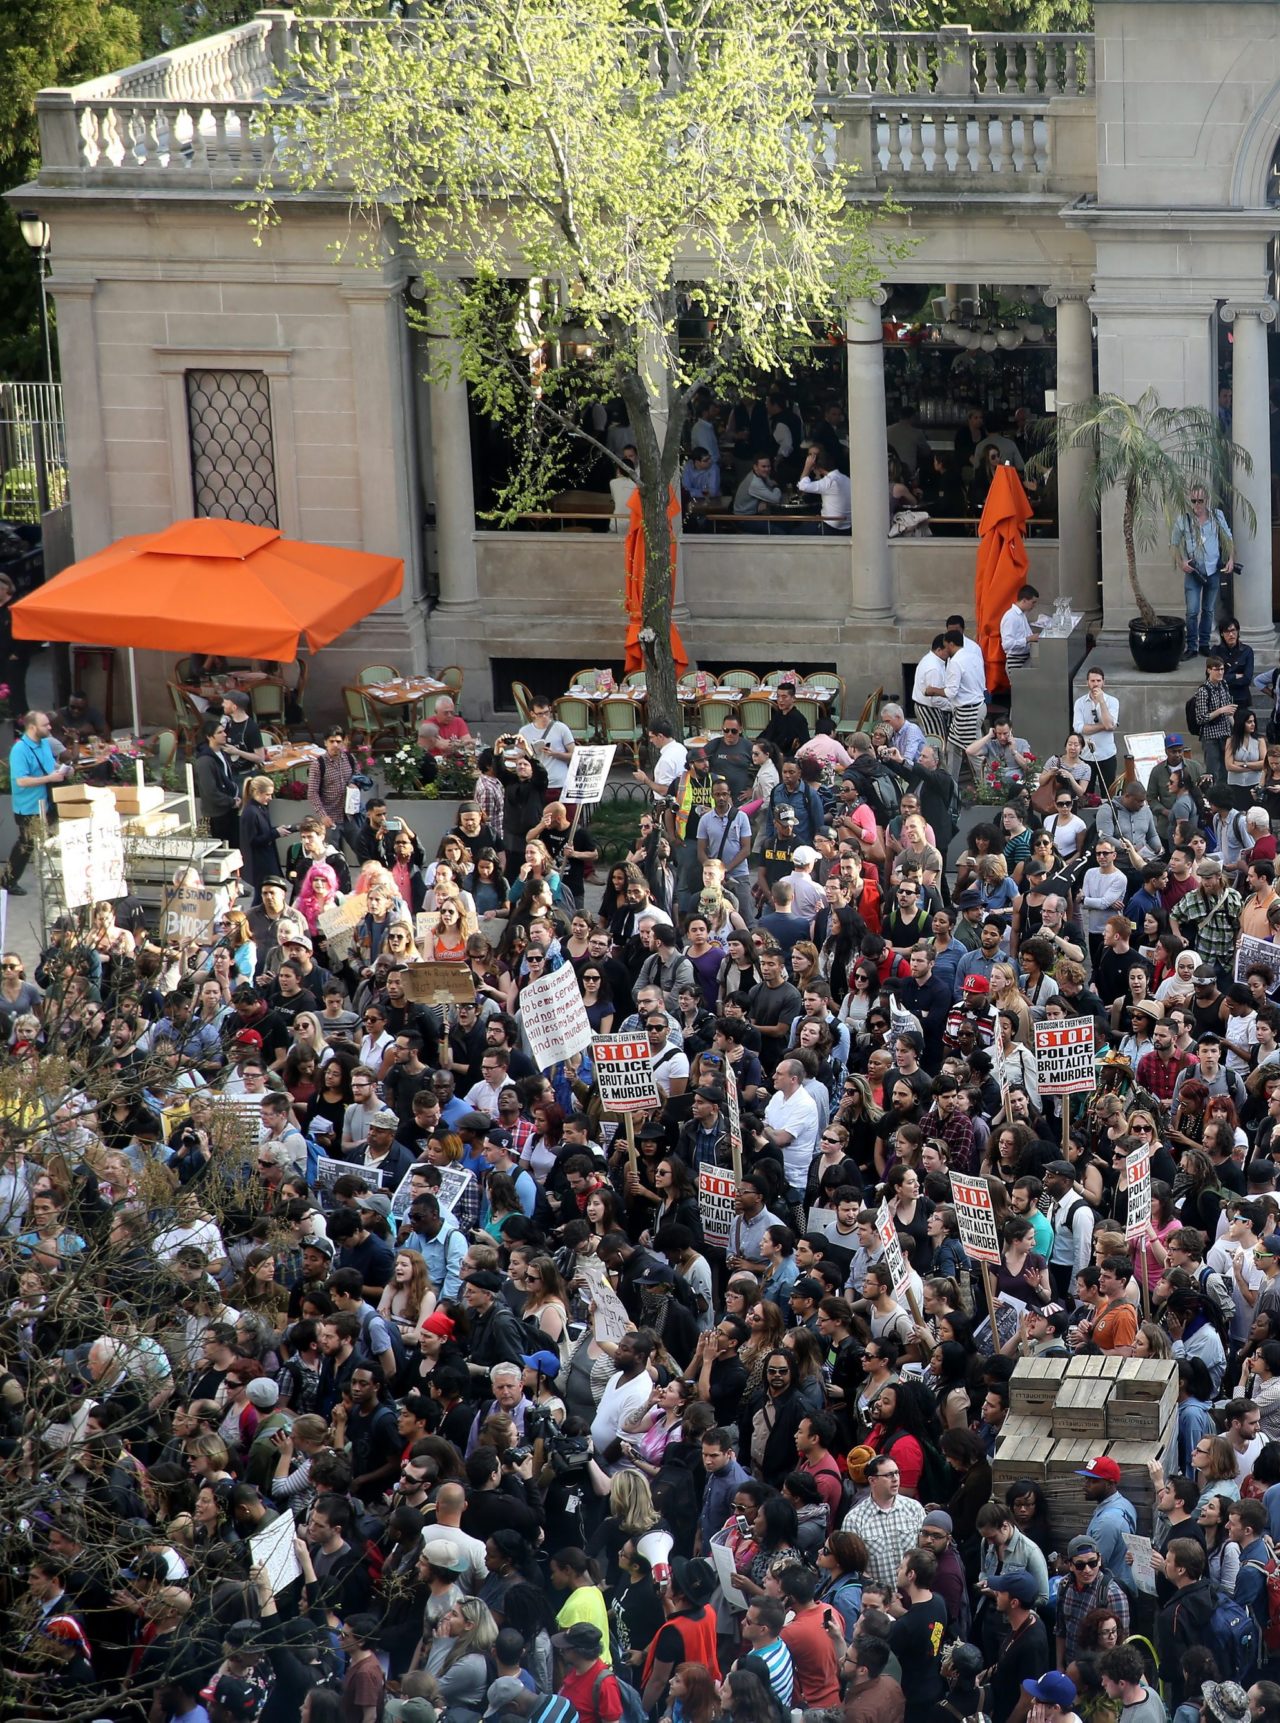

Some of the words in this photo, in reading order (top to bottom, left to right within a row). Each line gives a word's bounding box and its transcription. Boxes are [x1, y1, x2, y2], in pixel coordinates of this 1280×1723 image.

[186, 890, 213, 901] STAND
[531, 999, 543, 1010] be
[524, 1012, 540, 1028] and
[528, 1026, 541, 1040] still
[542, 1022, 558, 1034] less
[1038, 1027, 1091, 1047] STOP
[596, 1043, 646, 1060] STOP
[1037, 1042, 1093, 1060] POLICE
[597, 1060, 651, 1073] POLICE
[1037, 1053, 1093, 1072] BRUTALITY
[599, 1072, 652, 1086] BRUTALITY
[1037, 1072, 1046, 1084] &
[1050, 1066, 1094, 1083] MURDER
[601, 1087, 609, 1099] &
[611, 1084, 656, 1099] MURDER
[701, 1175, 736, 1196] STOP
[699, 1191, 736, 1211] POLICE
[953, 1185, 987, 1206] STOP
[956, 1202, 993, 1222] POLICE
[705, 1218, 731, 1235] MURD
[957, 1215, 995, 1236] BRUTALITY
[967, 1232, 998, 1251] MURDER
